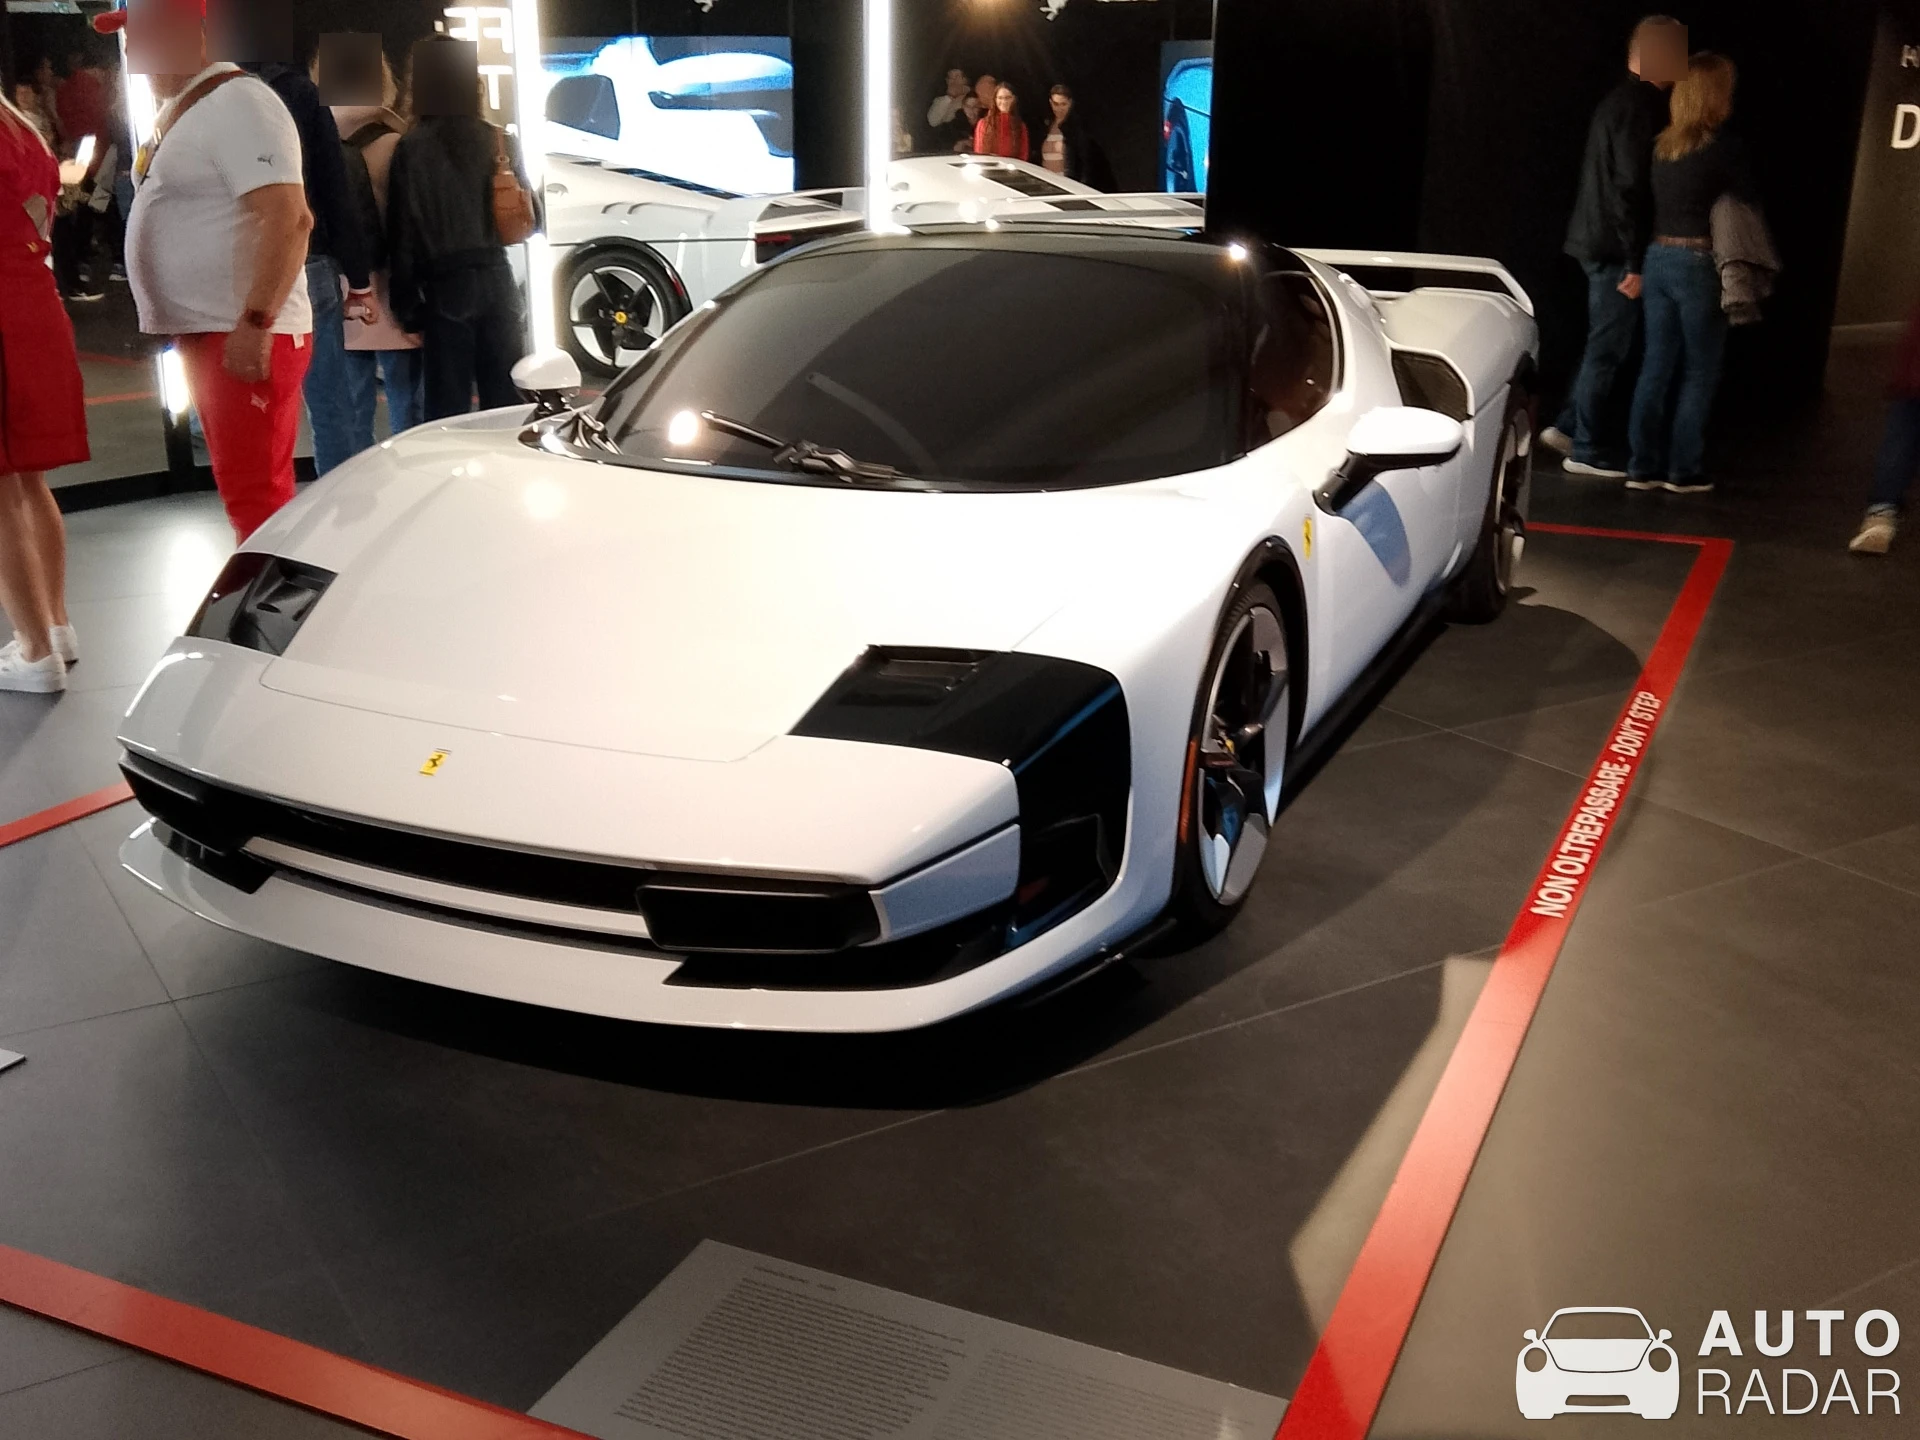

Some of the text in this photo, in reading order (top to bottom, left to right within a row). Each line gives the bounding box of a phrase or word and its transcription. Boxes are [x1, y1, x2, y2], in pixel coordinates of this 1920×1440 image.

[1628, 690, 1663, 721] STEP
[1609, 716, 1651, 757] DON'T
[1551, 760, 1631, 876] OLTREPASSARE
[1530, 873, 1579, 918] NON
